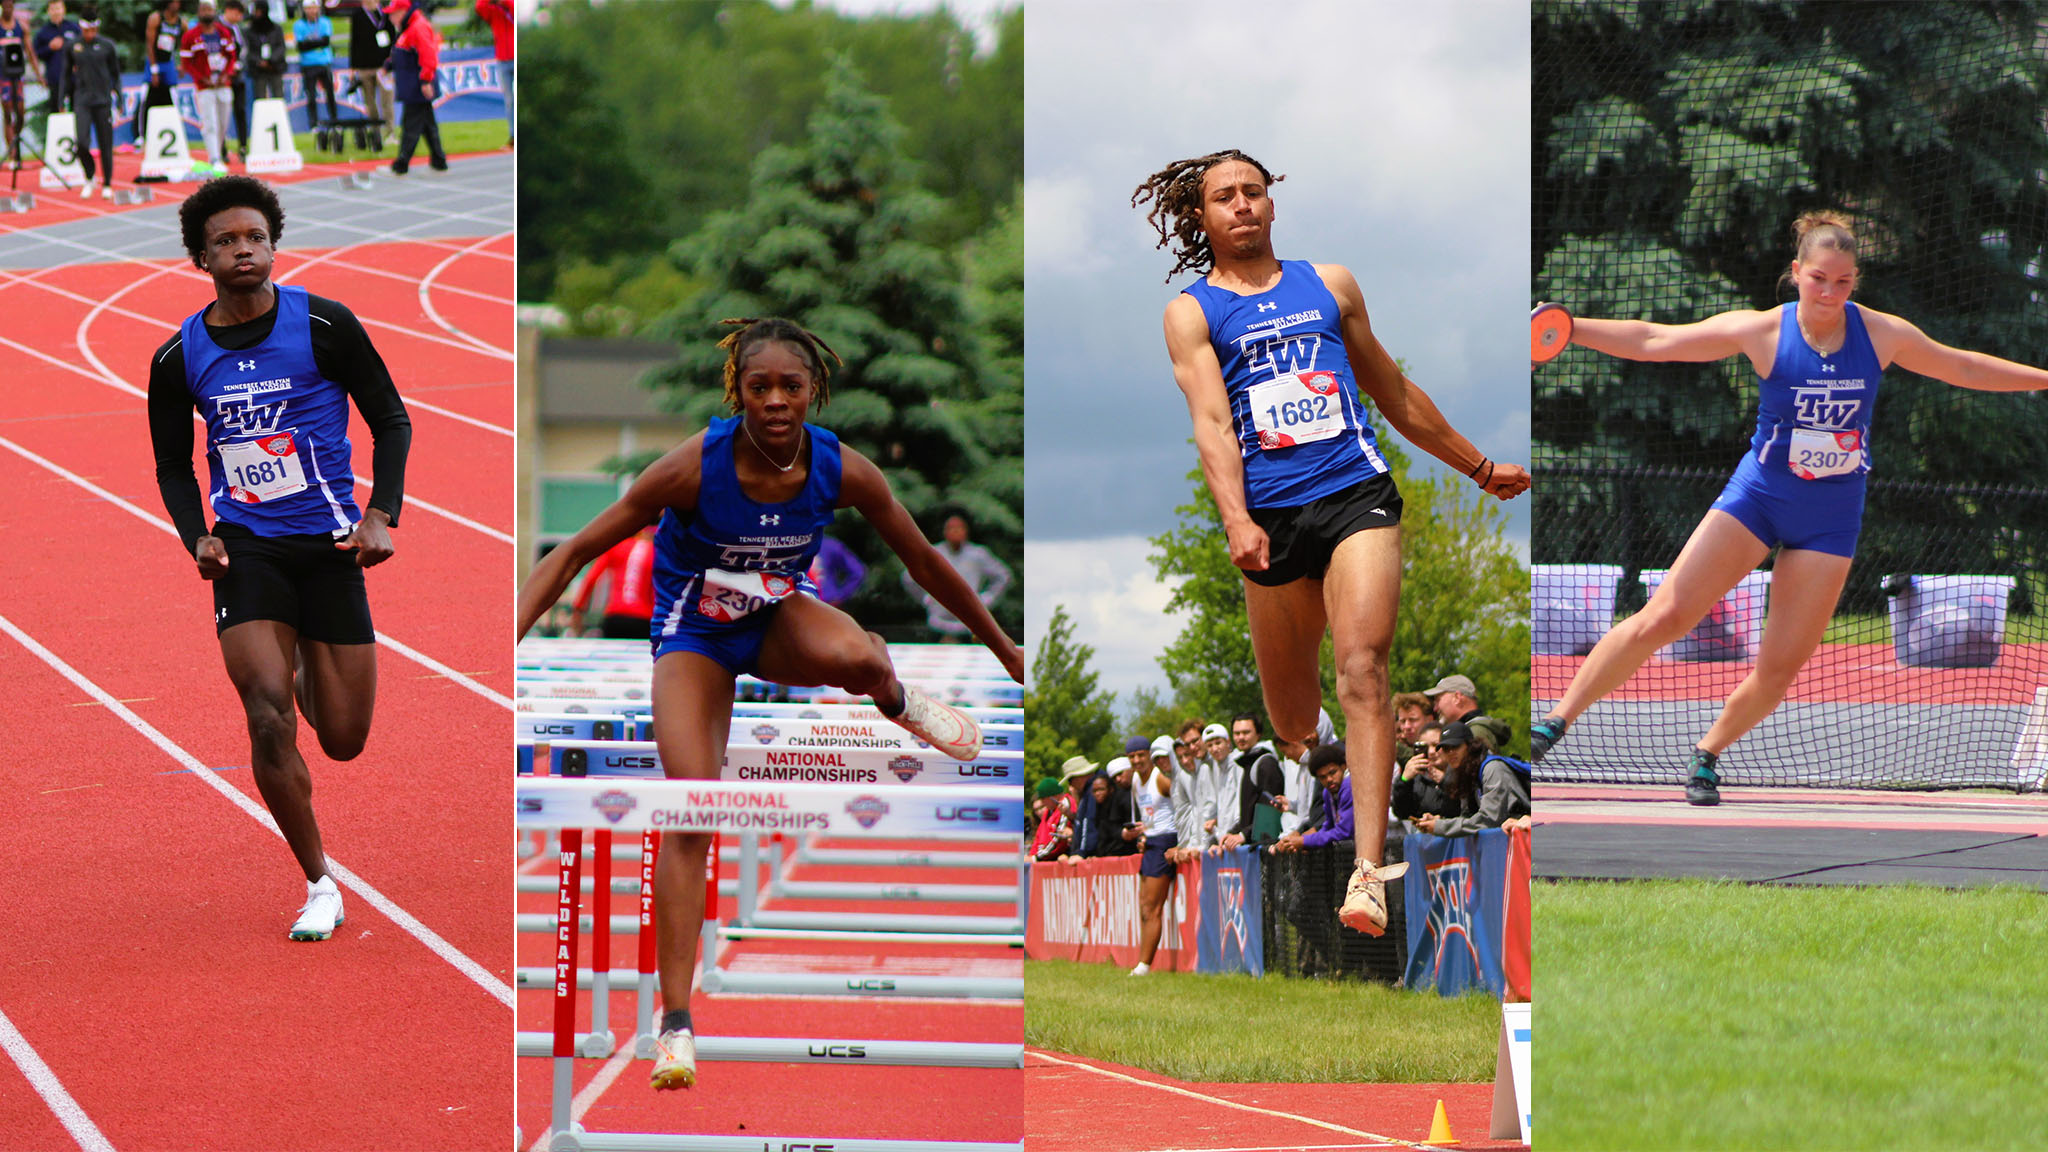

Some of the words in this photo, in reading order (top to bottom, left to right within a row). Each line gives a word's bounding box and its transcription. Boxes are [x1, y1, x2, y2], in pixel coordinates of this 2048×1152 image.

[157, 129, 177, 157] 2
[264, 123, 279, 151] 1
[57, 137, 78, 165] 3
[1240, 329, 1321, 379] TW
[223, 382, 258, 391] TENNESSEE
[259, 377, 290, 387] WESLEYAN
[217, 394, 288, 434] TW
[1266, 395, 1330, 429] 1682
[1794, 389, 1861, 428] TW
[1799, 449, 1850, 468] 2307
[234, 457, 287, 487] 1681
[739, 535, 778, 543] TENNESSEE
[715, 586, 778, 614] 230
[533, 725, 575, 735] UCS
[811, 725, 876, 737] NATIONAL
[788, 736, 902, 748] CHAMPIONSHIPS
[981, 736, 1009, 745] CS
[605, 756, 656, 769] UCS
[766, 752, 847, 767] NATIONAL
[738, 766, 878, 782] CHAMPIONSHIPS
[958, 765, 1009, 777] UCS
[686, 791, 790, 809] NATIONAL
[650, 809, 830, 829] CHAMPIONSHIPS
[935, 806, 1002, 822] UCS
[641, 828, 654, 926] LDCATS
[556, 852, 576, 997] WILDCATS
[847, 979, 896, 991] UCS
[808, 1045, 866, 1058] UCS
